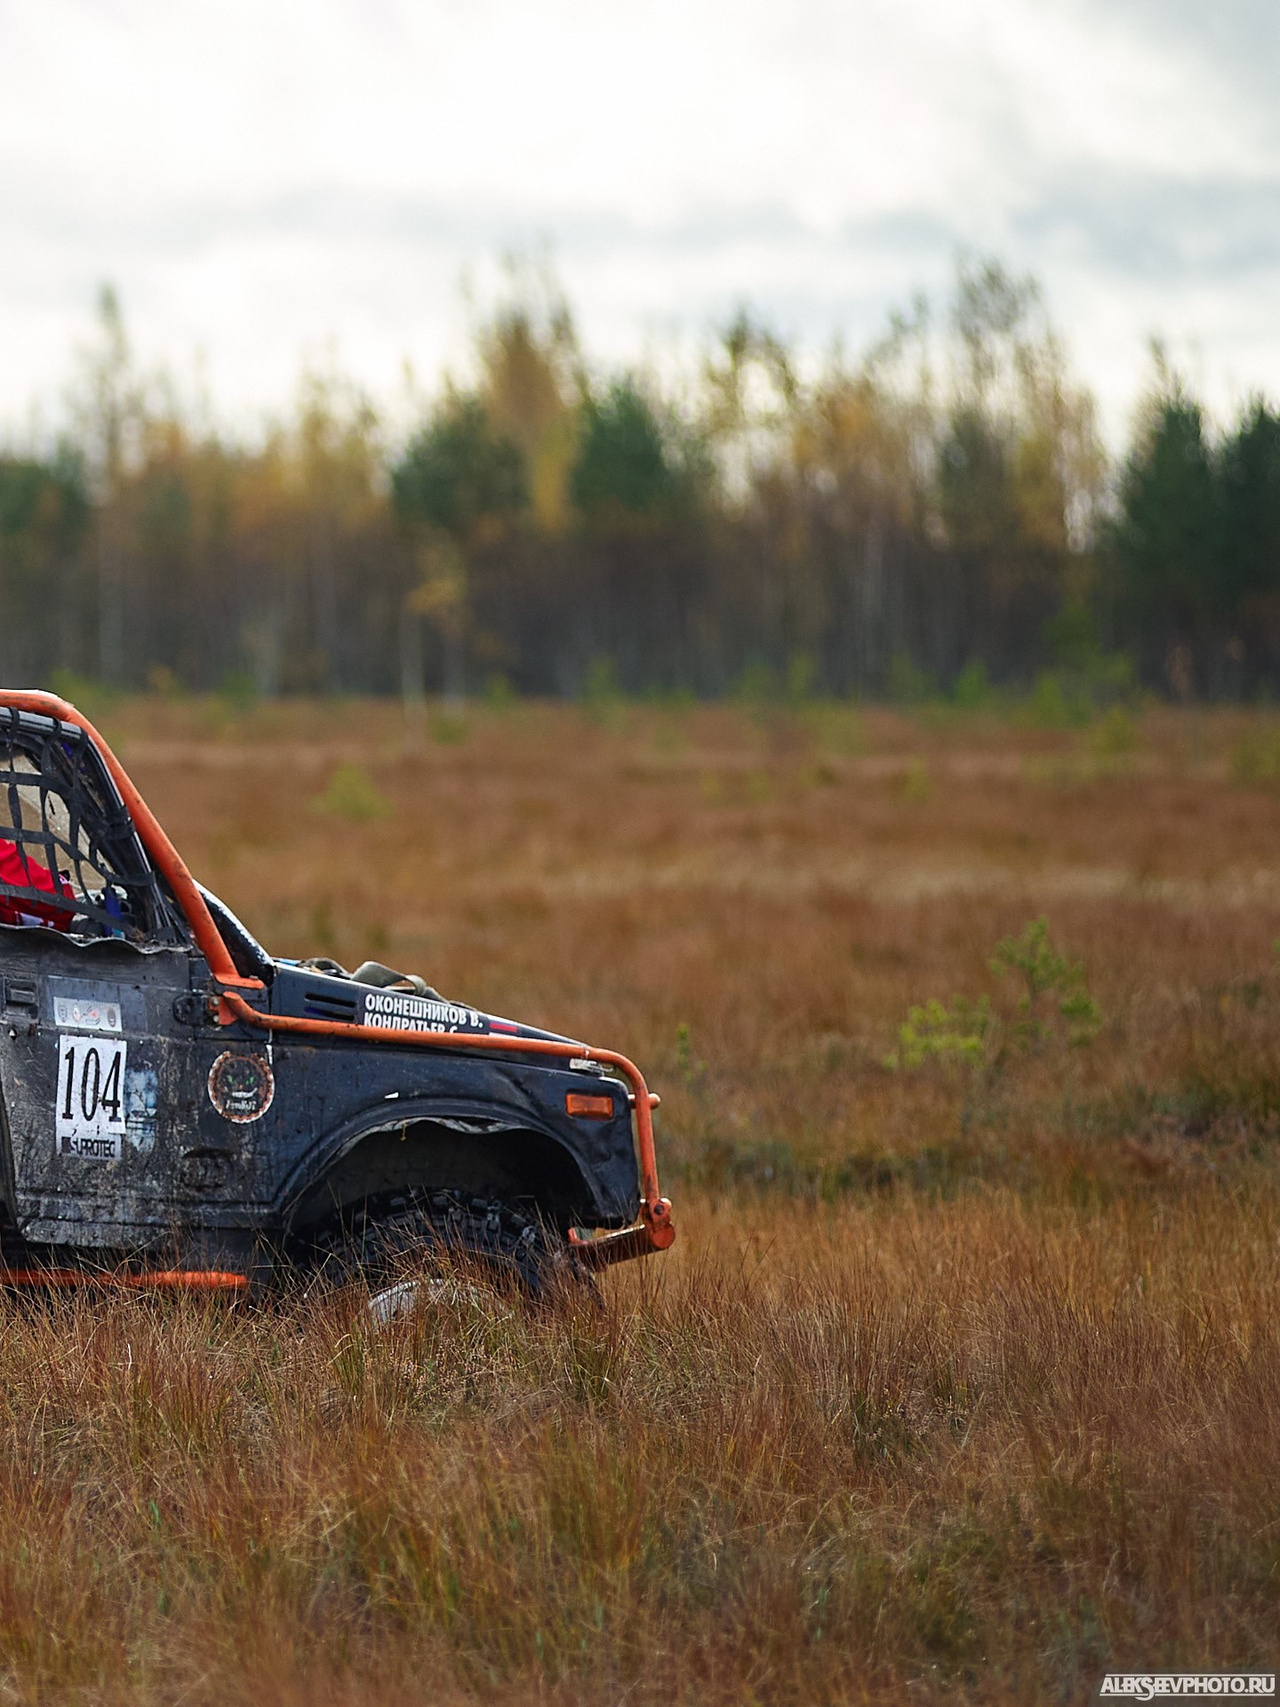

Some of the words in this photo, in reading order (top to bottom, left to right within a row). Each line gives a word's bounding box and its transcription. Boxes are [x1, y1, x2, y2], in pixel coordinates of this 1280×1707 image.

[365, 993, 467, 1025] ОКОНЕШНИКОВ
[470, 1011, 483, 1028] В.
[61, 1046, 122, 1123] 104
